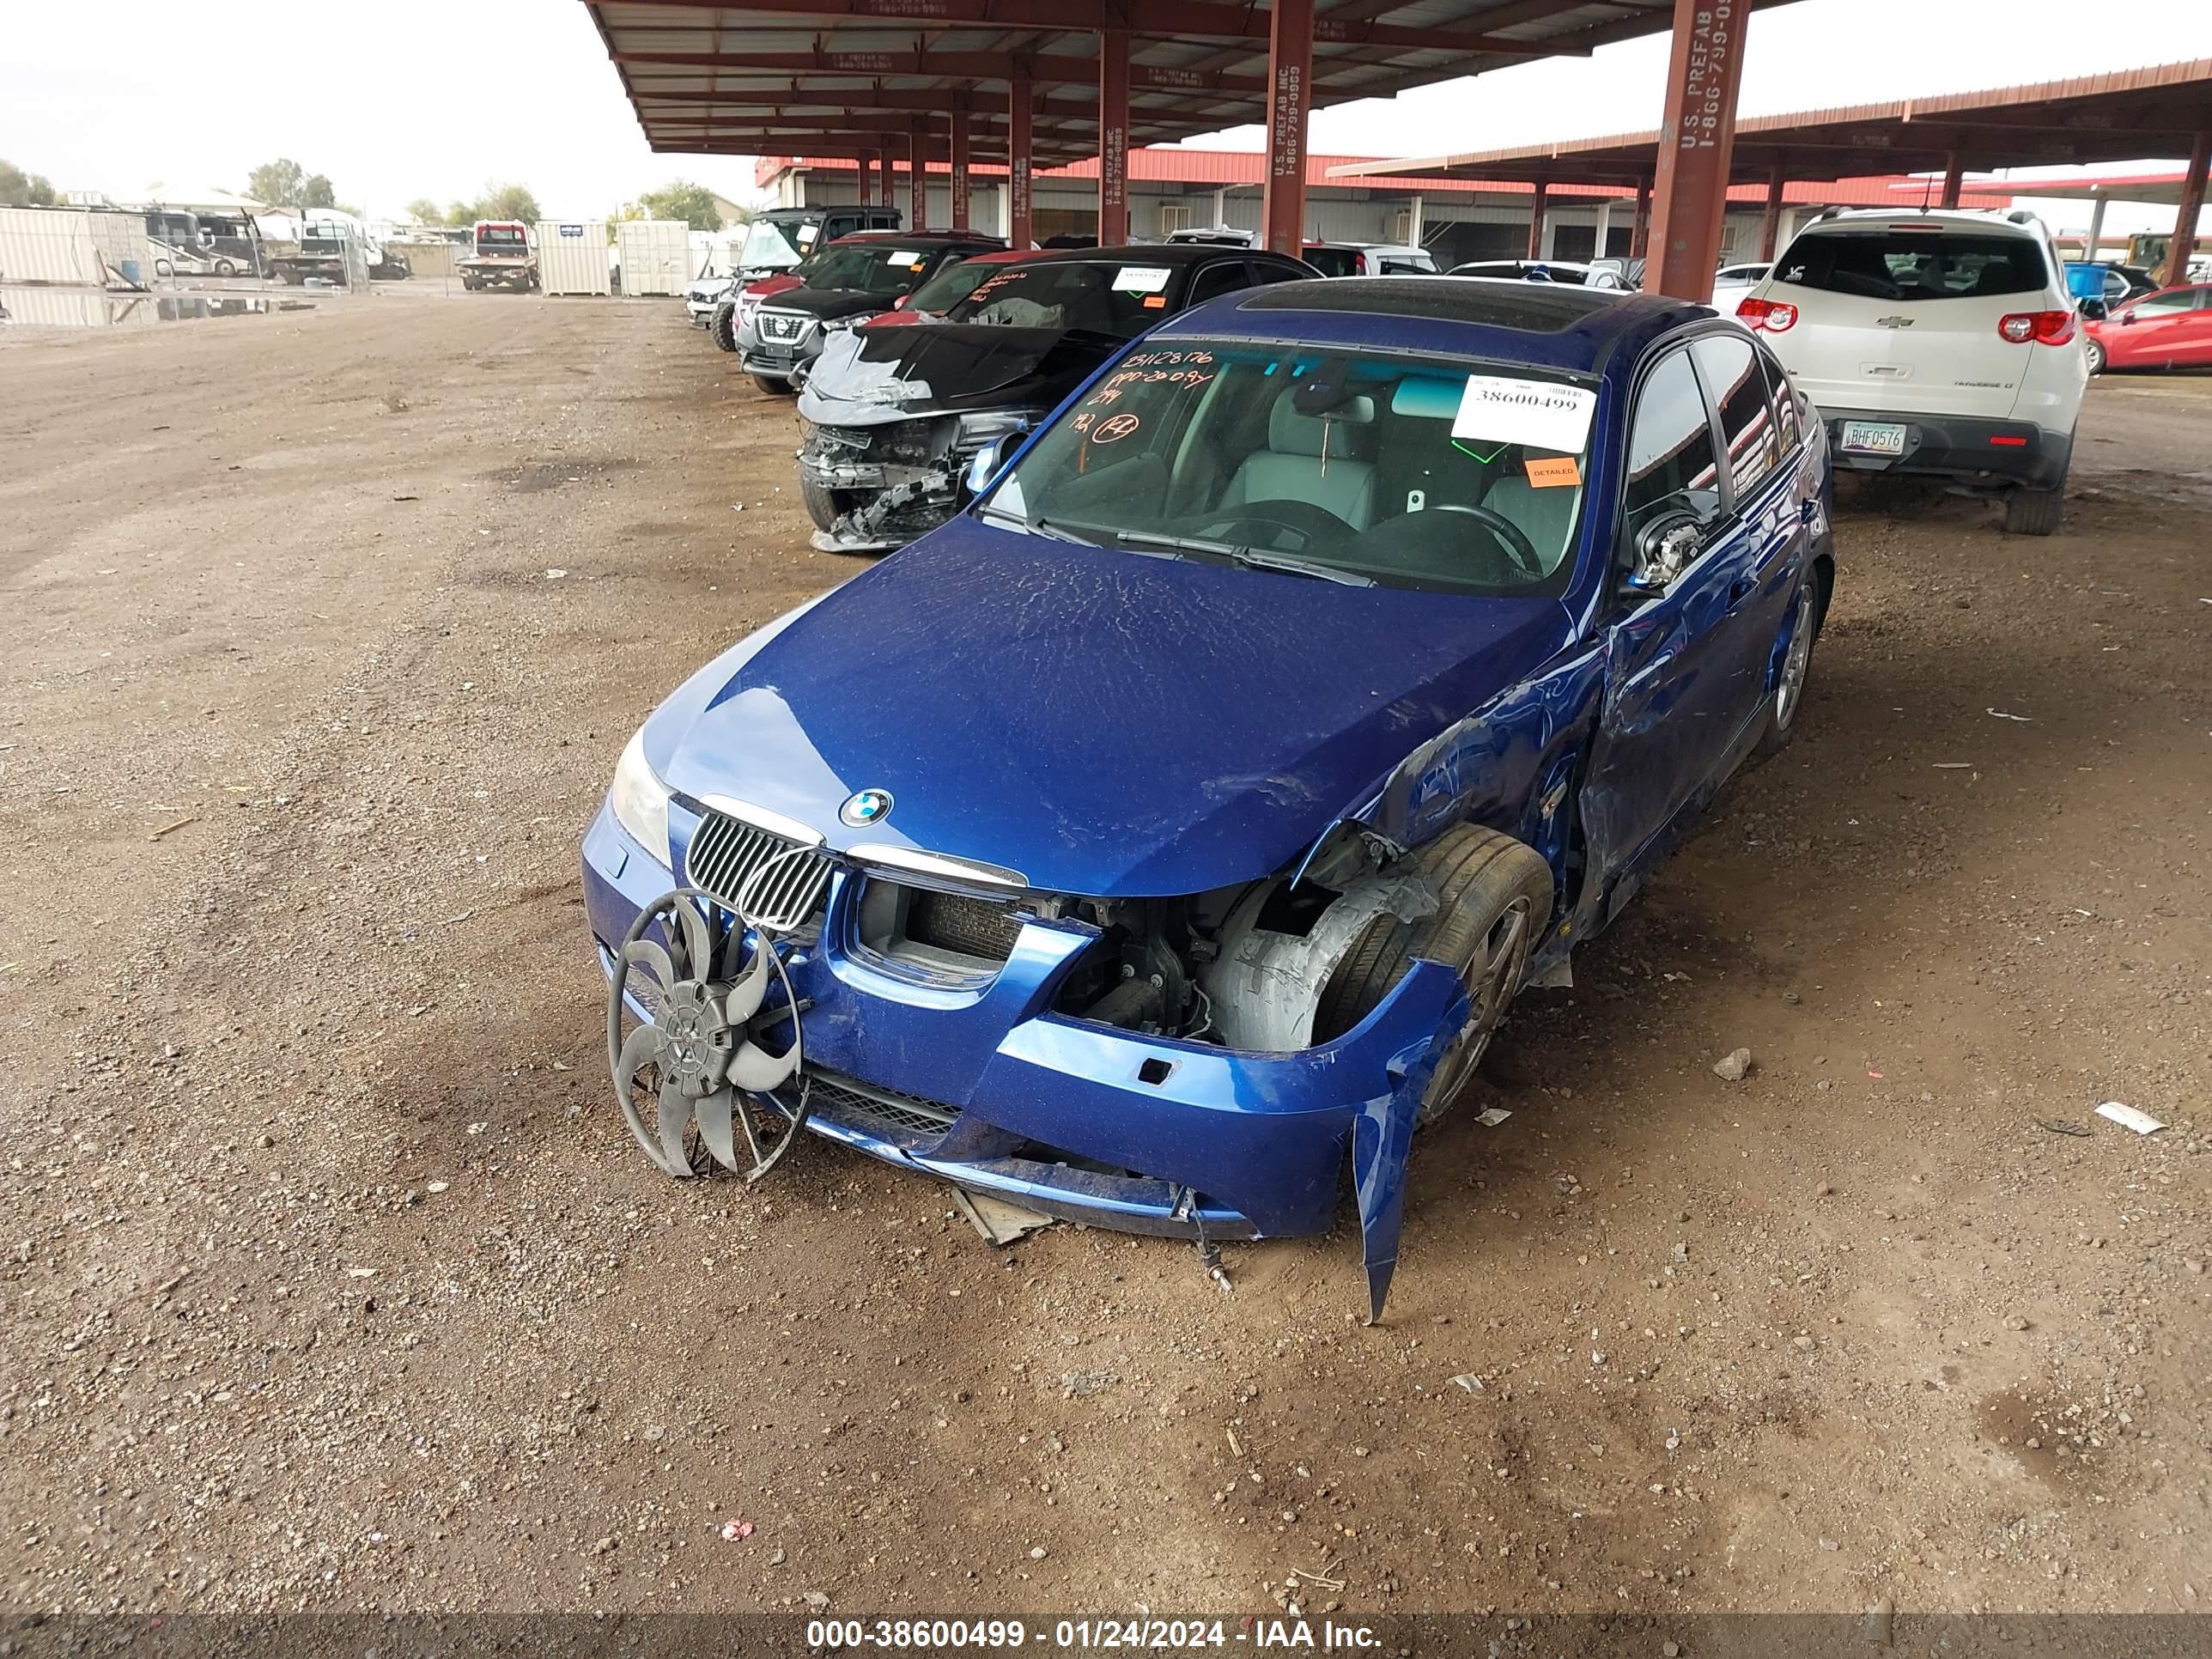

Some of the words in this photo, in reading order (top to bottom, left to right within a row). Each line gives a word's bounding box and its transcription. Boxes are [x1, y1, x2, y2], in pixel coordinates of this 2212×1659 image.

[1686, 10, 1712, 96] PREFAB
[1279, 64, 1290, 89] INC.
[1276, 96, 1288, 145] PREFAB
[1286, 66, 1301, 175] 1-866-799-0969
[1680, 108, 1701, 149] U.S.
[1274, 151, 1285, 176] U.S.
[1475, 389, 1577, 412] 38600499
[1851, 428, 1902, 447] BHF0576
[1534, 467, 1575, 477] DETAILED
